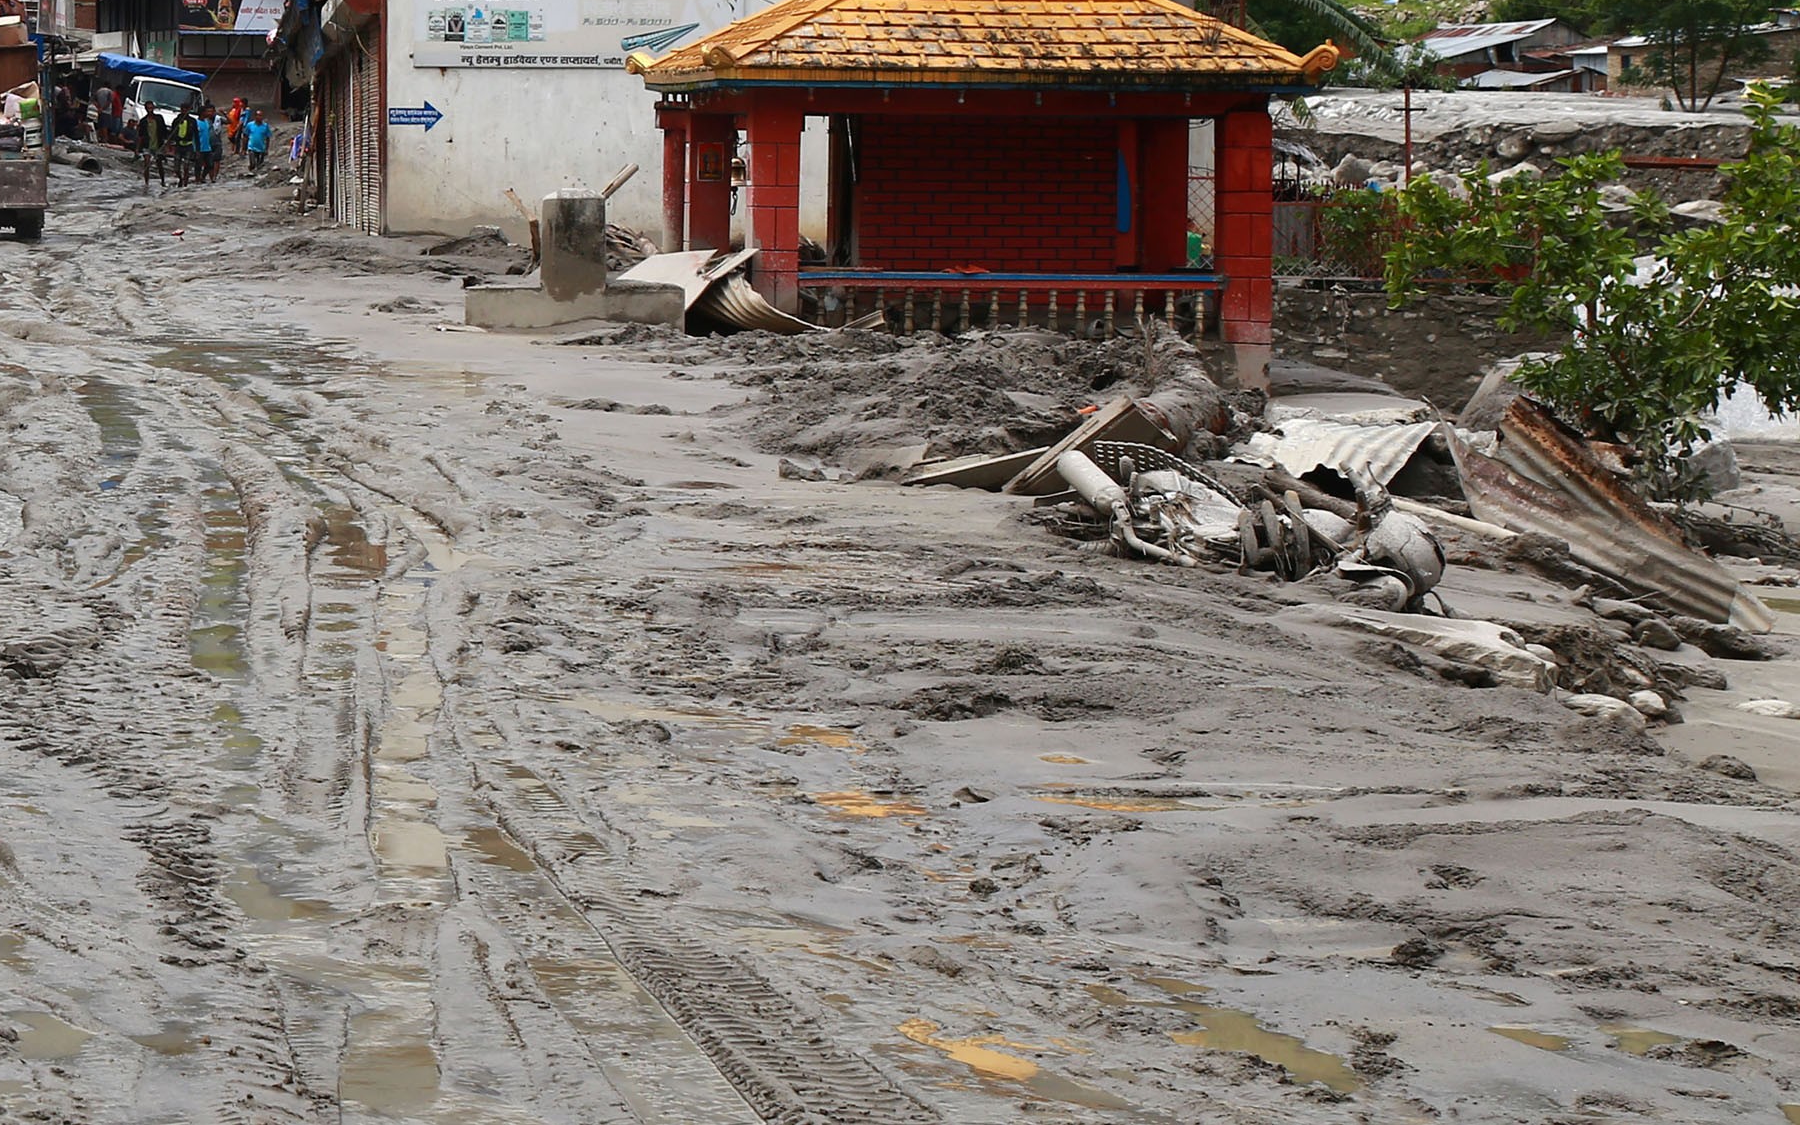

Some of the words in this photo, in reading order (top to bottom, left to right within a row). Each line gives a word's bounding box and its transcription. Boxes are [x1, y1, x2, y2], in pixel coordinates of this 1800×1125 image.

[461, 55, 473, 66] न्यू
[503, 55, 537, 65] हार्डवेयर
[539, 55, 558, 65] एण्ड
